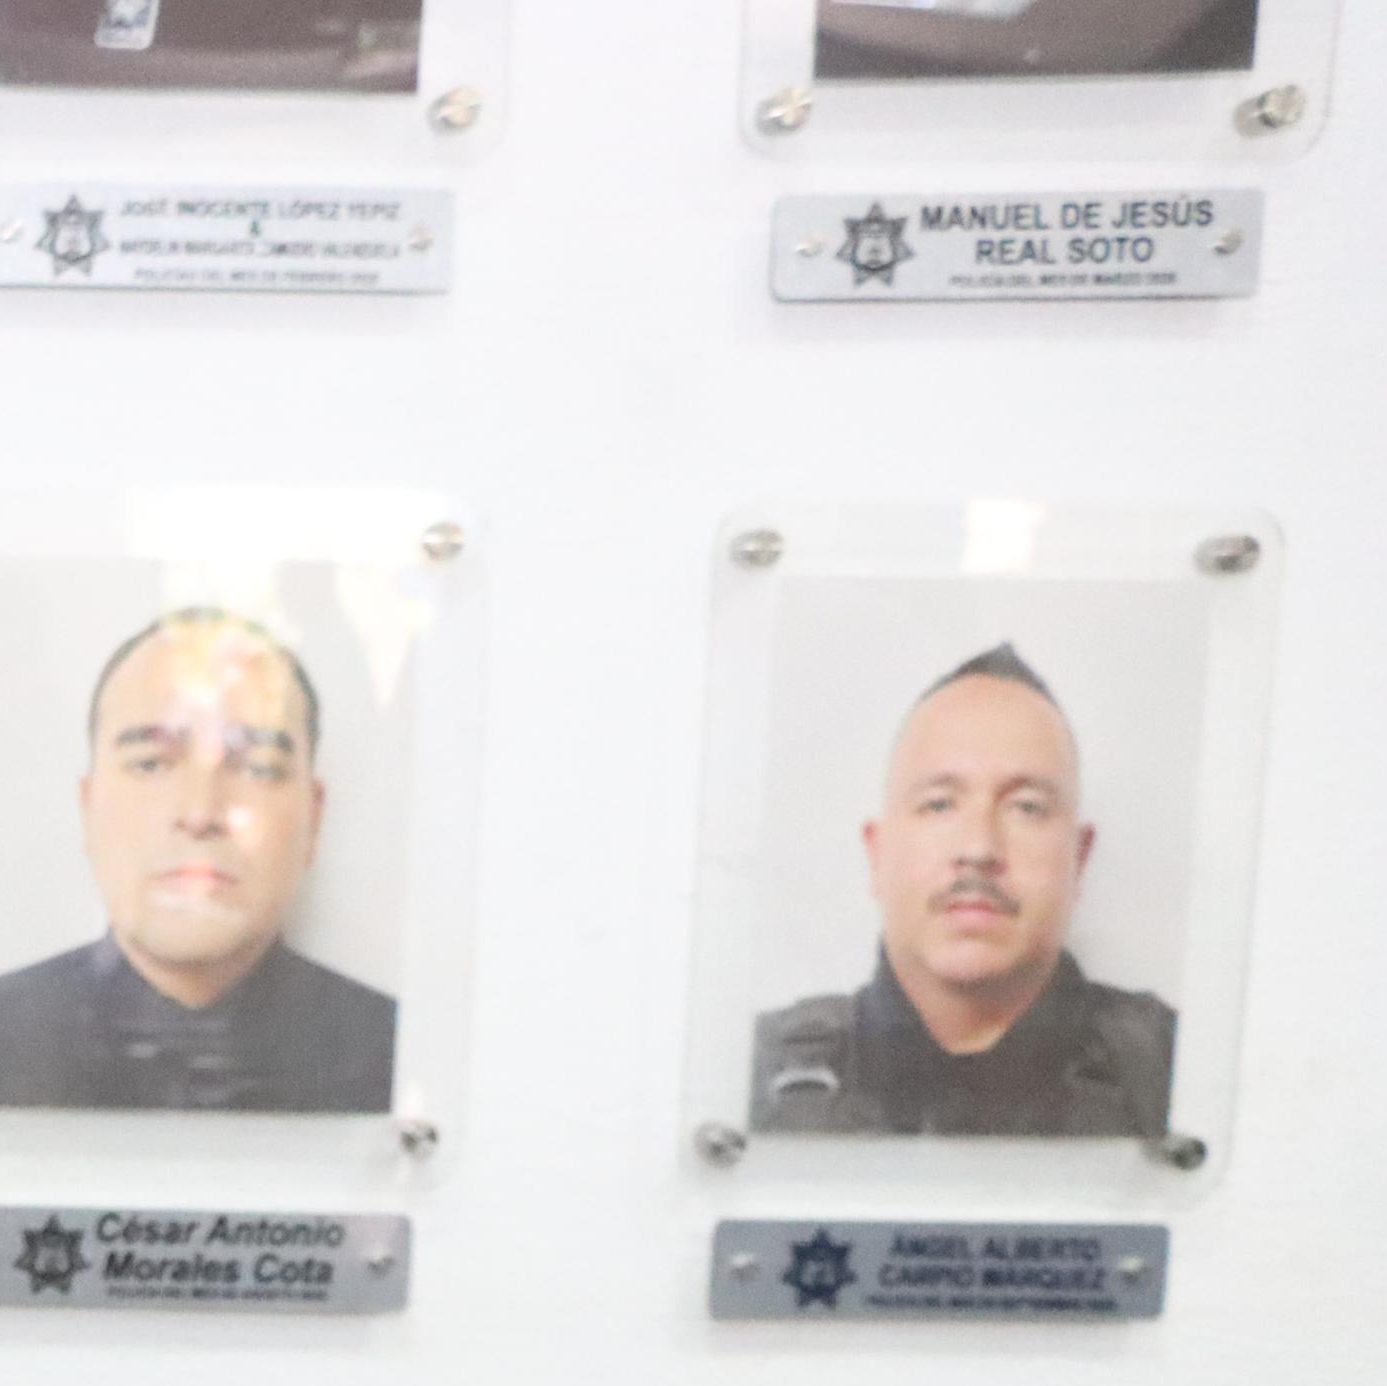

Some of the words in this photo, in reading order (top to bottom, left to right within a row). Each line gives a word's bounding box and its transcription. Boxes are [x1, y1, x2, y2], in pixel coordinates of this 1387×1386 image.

[278, 199, 341, 220] LÓPEZ
[920, 204, 1051, 230] MANUEL
[1059, 202, 1102, 229] DE
[1112, 195, 1214, 229] JESÚS
[975, 238, 1057, 265] REAL
[1066, 236, 1156, 264] SOTO
[96, 1211, 200, 1245] César
[204, 1214, 346, 1248] Antonio
[103, 1251, 241, 1281] Morales
[253, 1252, 335, 1283] Cota
